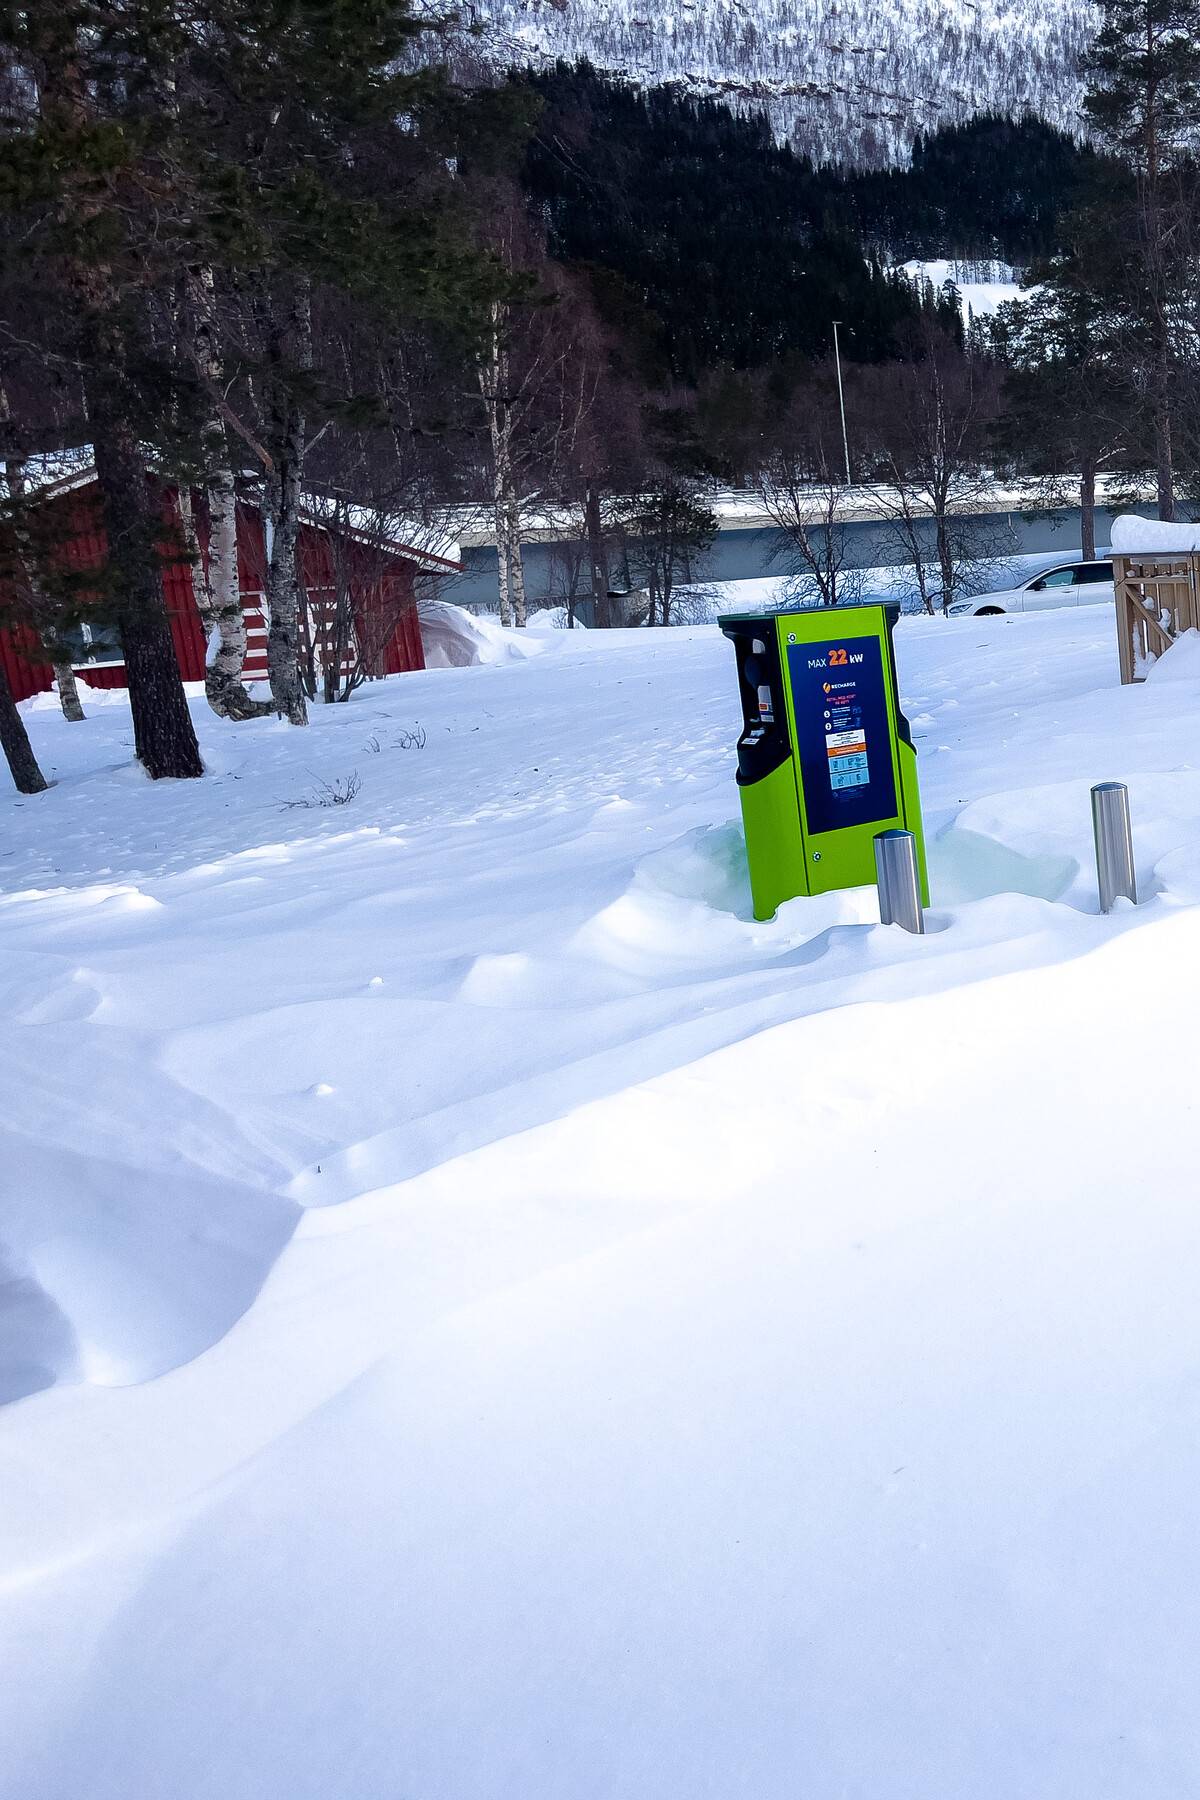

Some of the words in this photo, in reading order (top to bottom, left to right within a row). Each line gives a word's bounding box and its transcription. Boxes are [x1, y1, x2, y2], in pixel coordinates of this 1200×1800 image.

[808, 658, 827, 669] MAX
[828, 649, 848, 666] 22
[849, 653, 863, 664] kW
